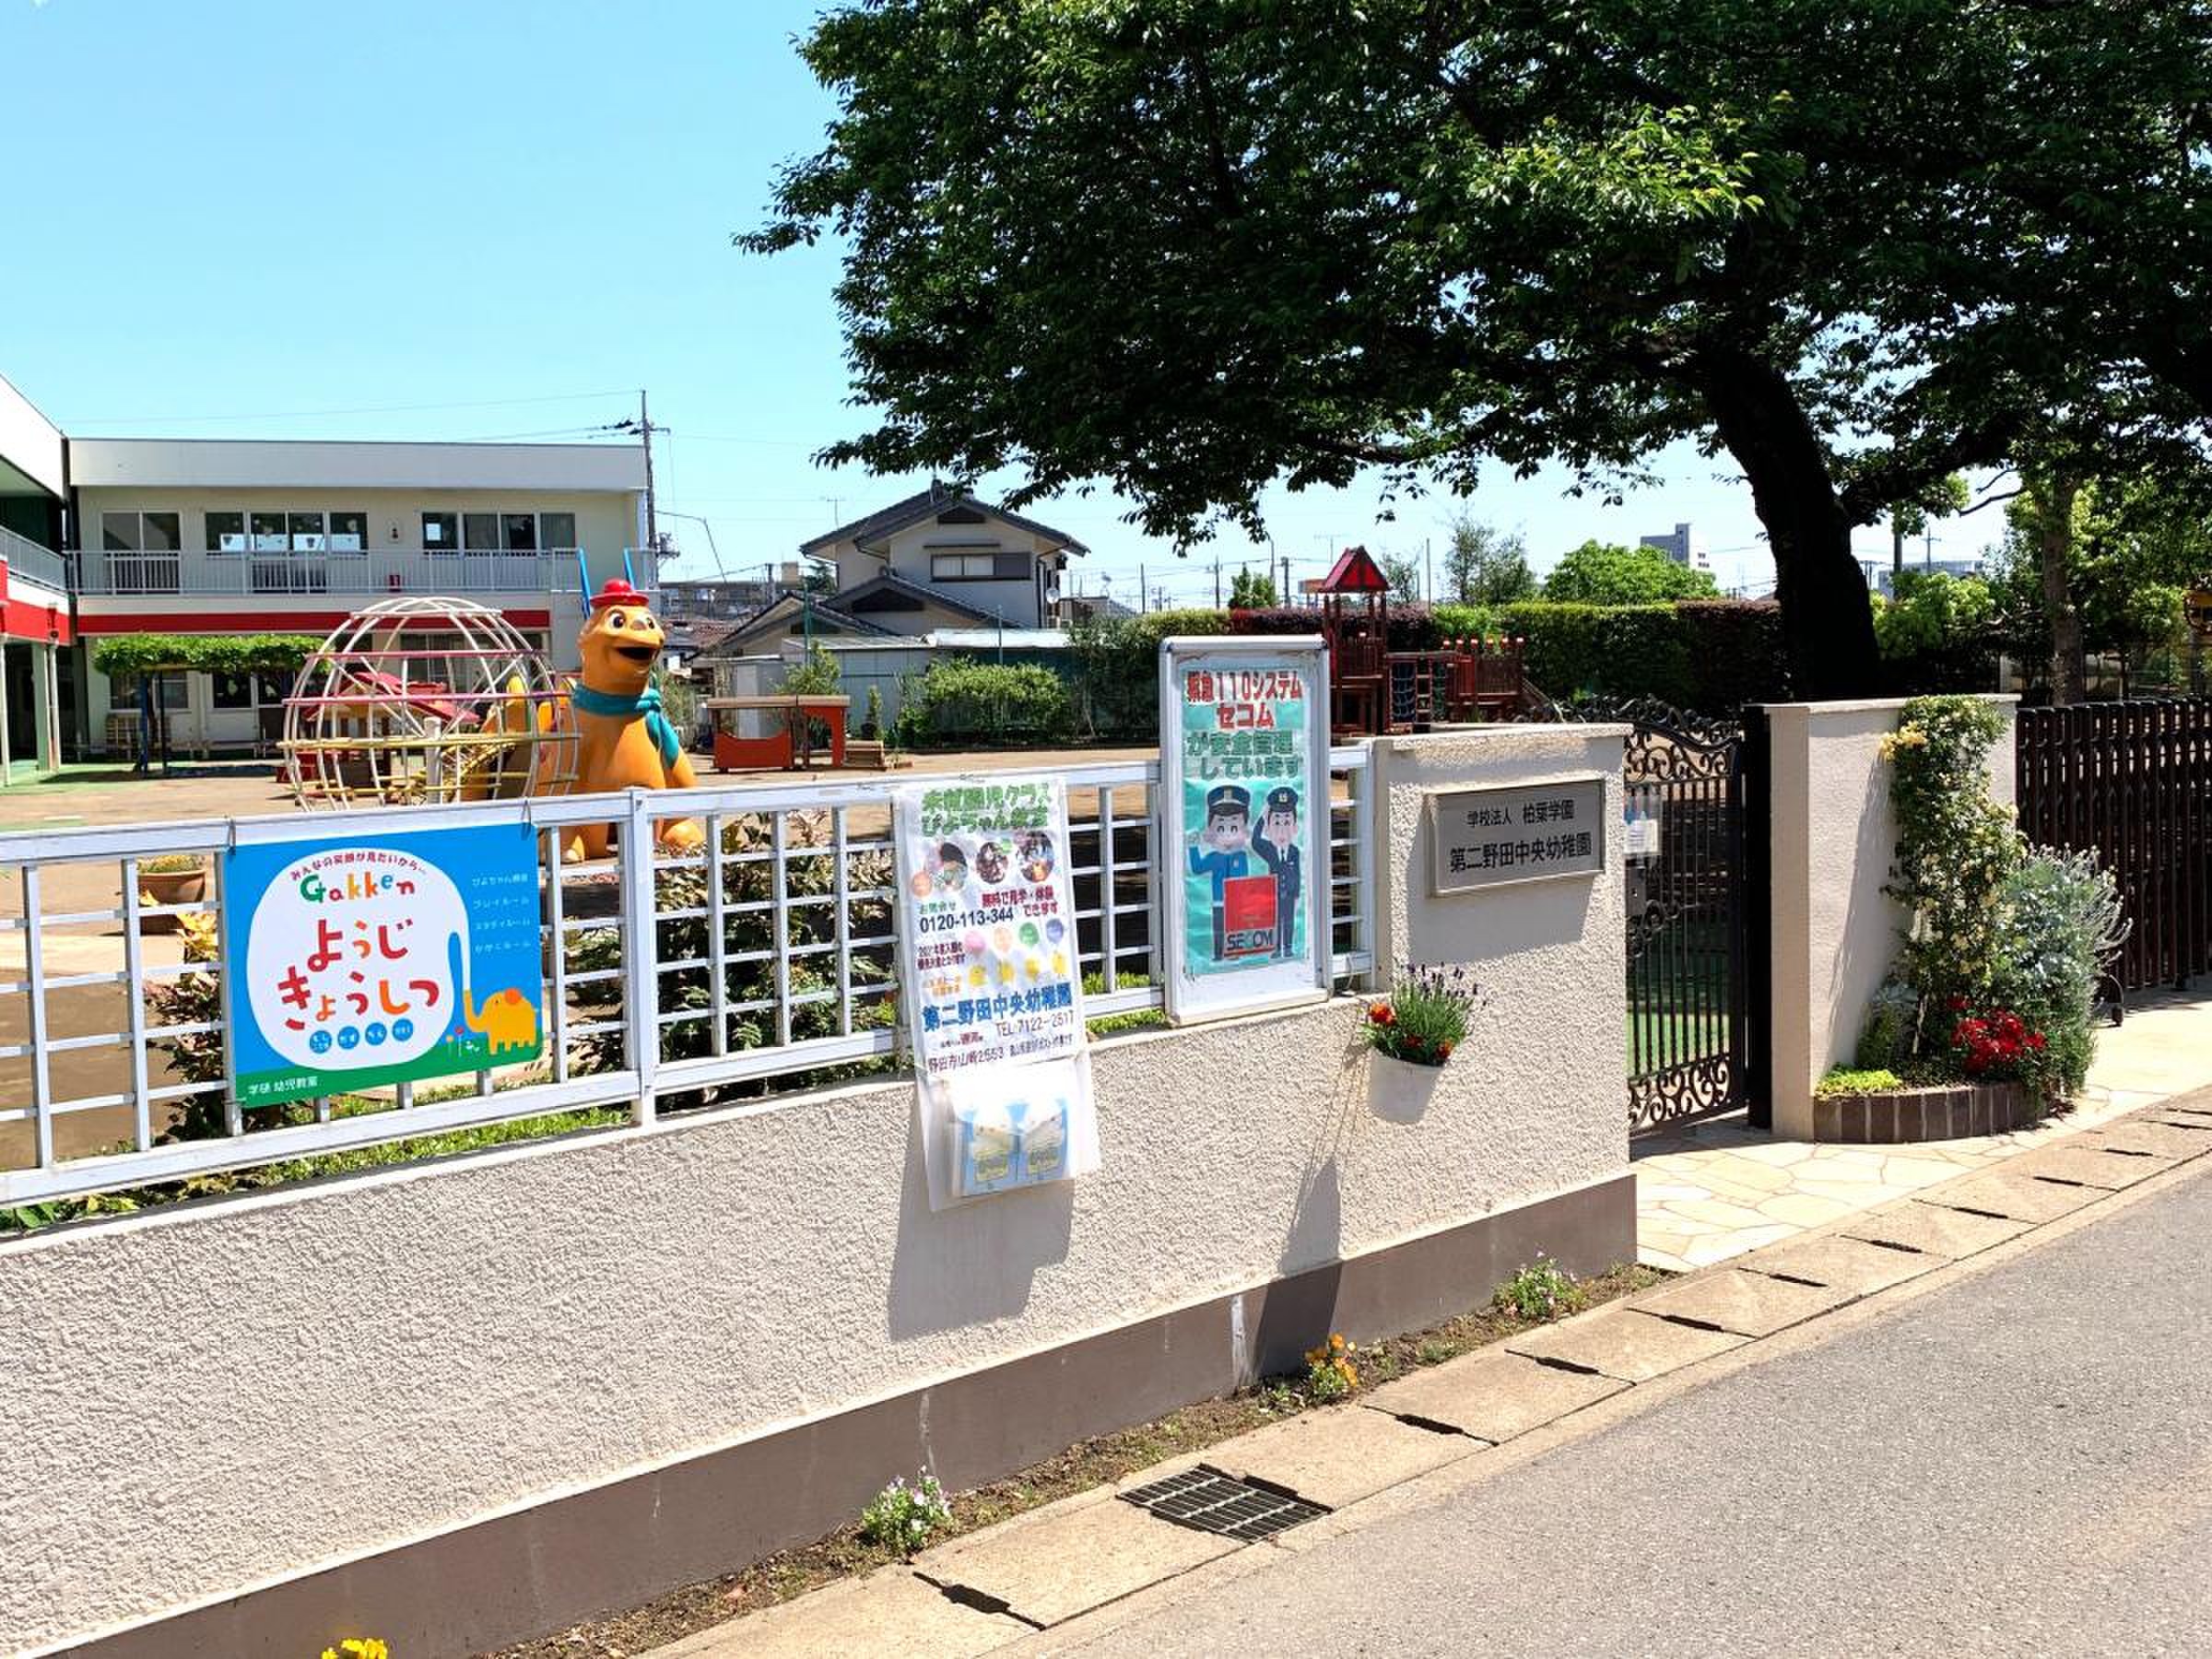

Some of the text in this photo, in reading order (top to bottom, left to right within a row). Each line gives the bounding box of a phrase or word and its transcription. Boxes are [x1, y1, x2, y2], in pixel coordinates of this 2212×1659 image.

[1216, 702, 1275, 730] セコム
[1186, 731, 1293, 757] が安全管理
[1200, 754, 1304, 782] しています
[1466, 806, 1512, 829] 学校法人
[1450, 831, 1592, 874] 第二野田中央幼稚園
[300, 871, 415, 903] Gakken
[919, 906, 1014, 934] 0120-113-344
[1023, 902, 1059, 918] できます
[307, 918, 414, 973] ようじ
[1227, 929, 1274, 952] SECOM
[277, 965, 441, 1031] きょうしつ
[922, 982, 1073, 1033] 第二野田中央幼稚園
